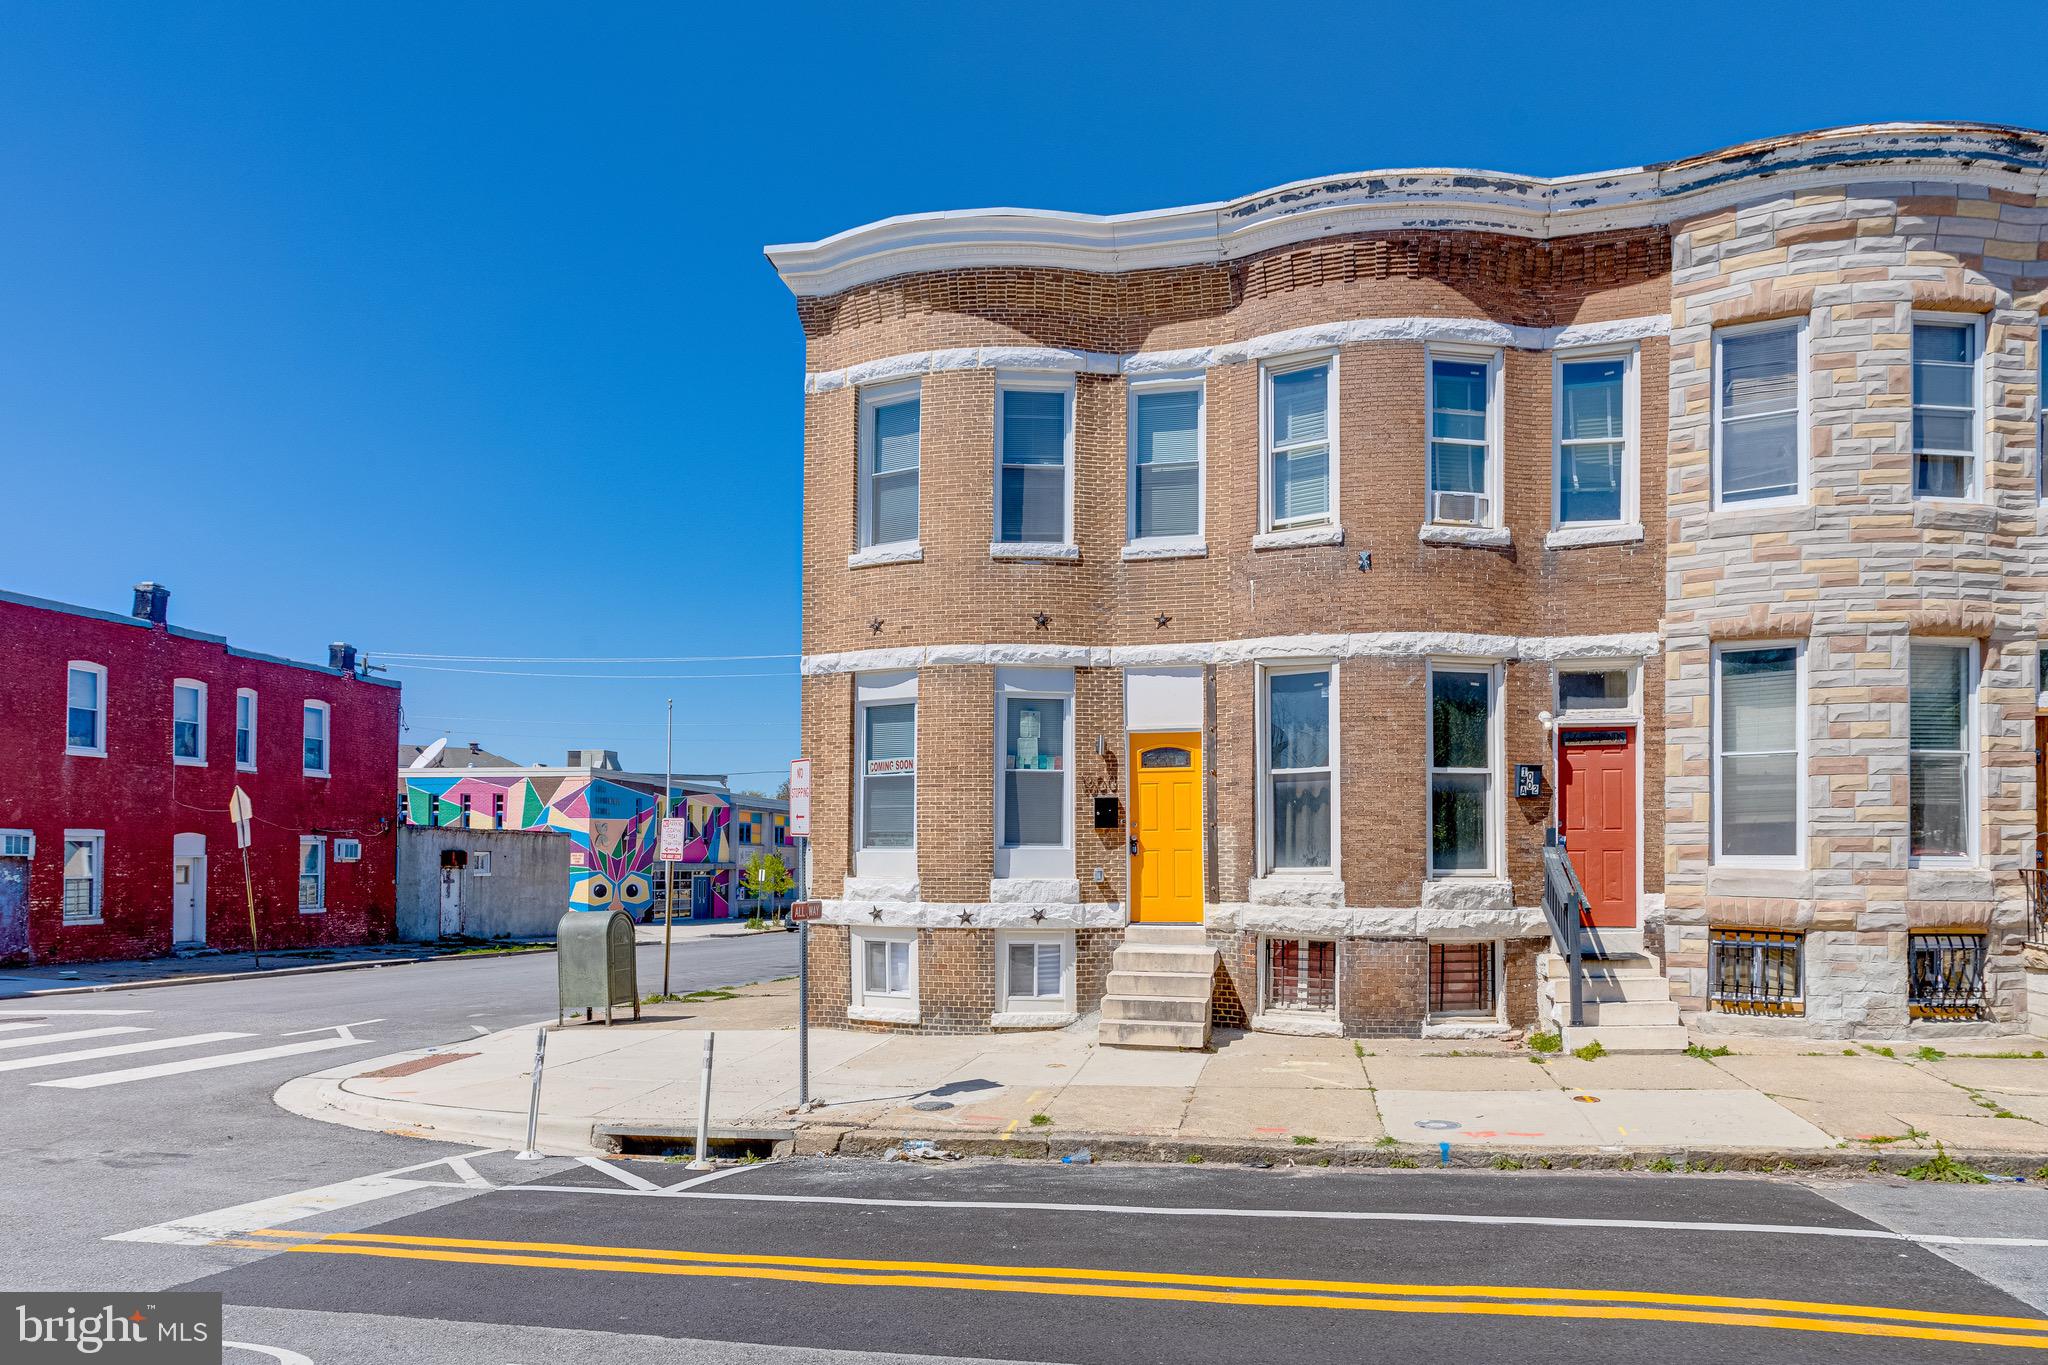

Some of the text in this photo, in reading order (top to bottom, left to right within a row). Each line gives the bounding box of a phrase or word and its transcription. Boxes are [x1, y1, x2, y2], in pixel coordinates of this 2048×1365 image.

[870, 759, 913, 772] COMING SOON
[797, 768, 803, 779] NO
[791, 787, 809, 798] STOPPING
[794, 904, 820, 918] ALL WAY
